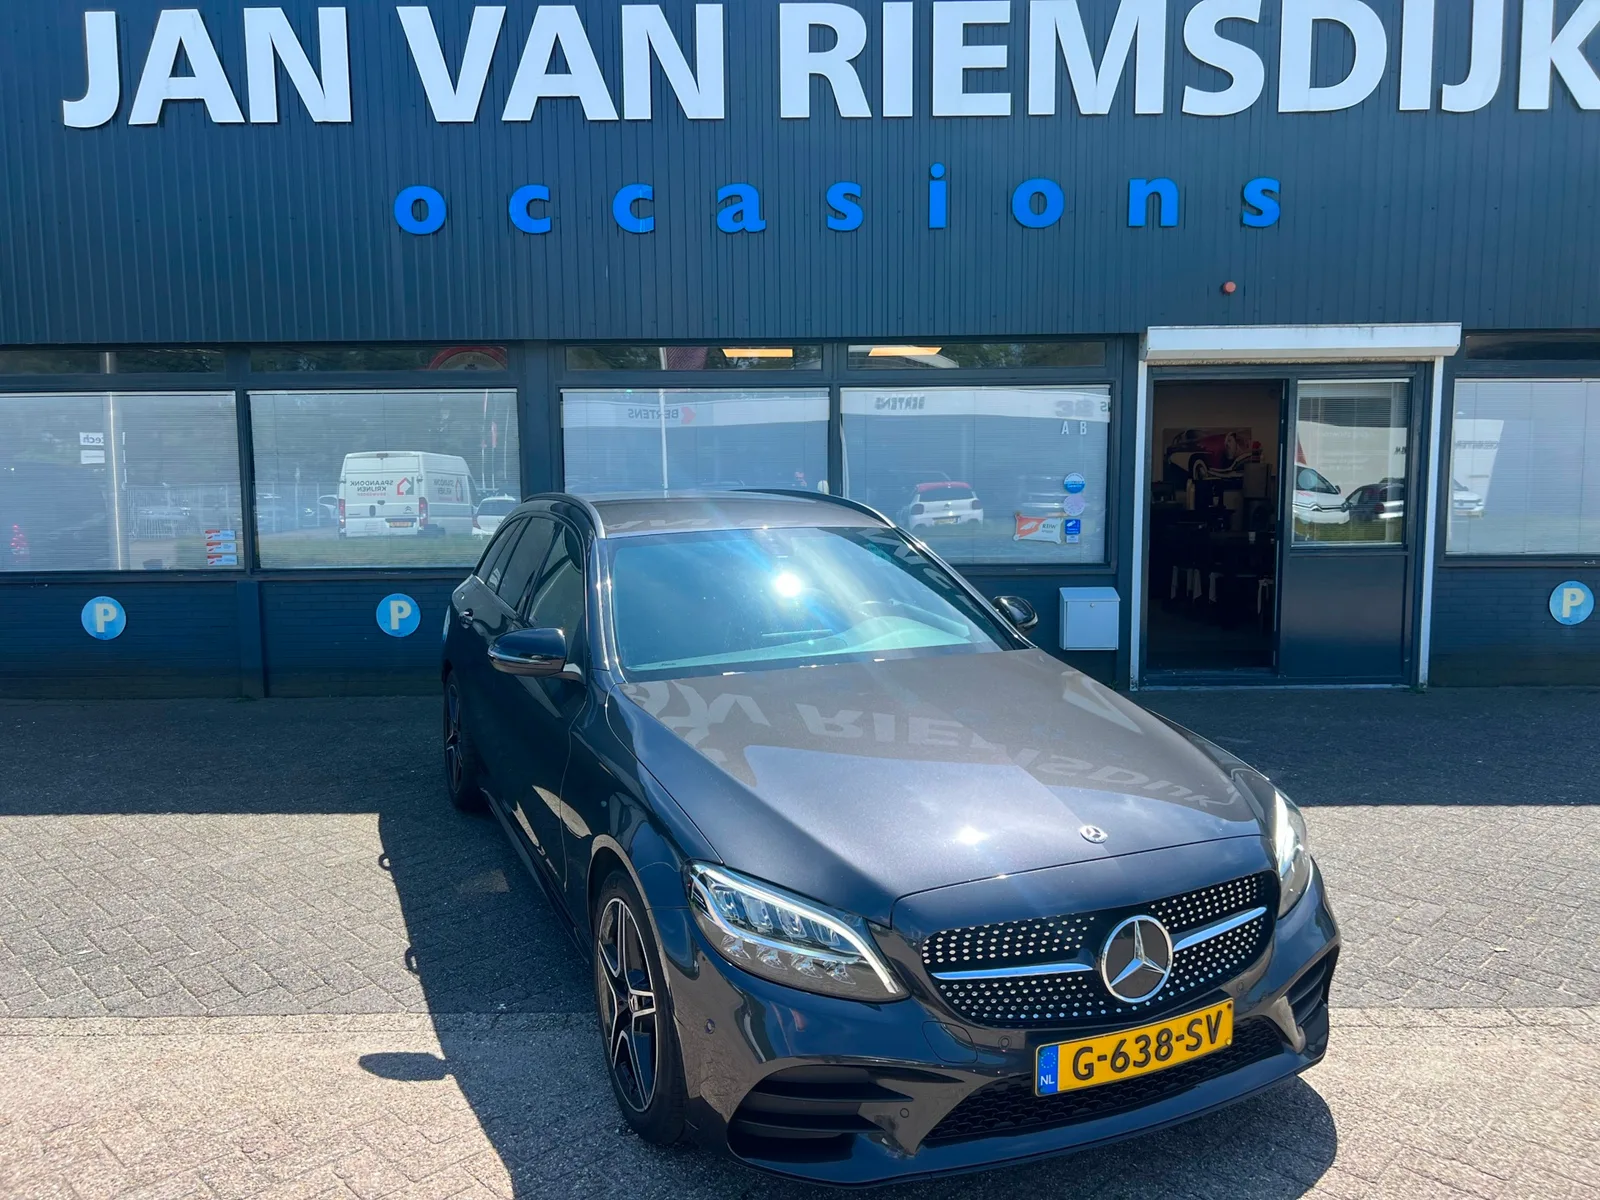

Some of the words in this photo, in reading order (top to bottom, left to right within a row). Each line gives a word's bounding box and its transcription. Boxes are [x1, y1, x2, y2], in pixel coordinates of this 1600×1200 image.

[62, 6, 352, 128] JAN
[395, 4, 725, 122] VAN
[779, 0, 1600, 118] RIEMSDIJK
[393, 163, 1281, 235] occasions
[95, 603, 117, 633] P
[390, 600, 411, 631] P
[1562, 588, 1584, 618] P
[1072, 1010, 1223, 1081] G-638-SV
[1040, 1074, 1055, 1086] NL
